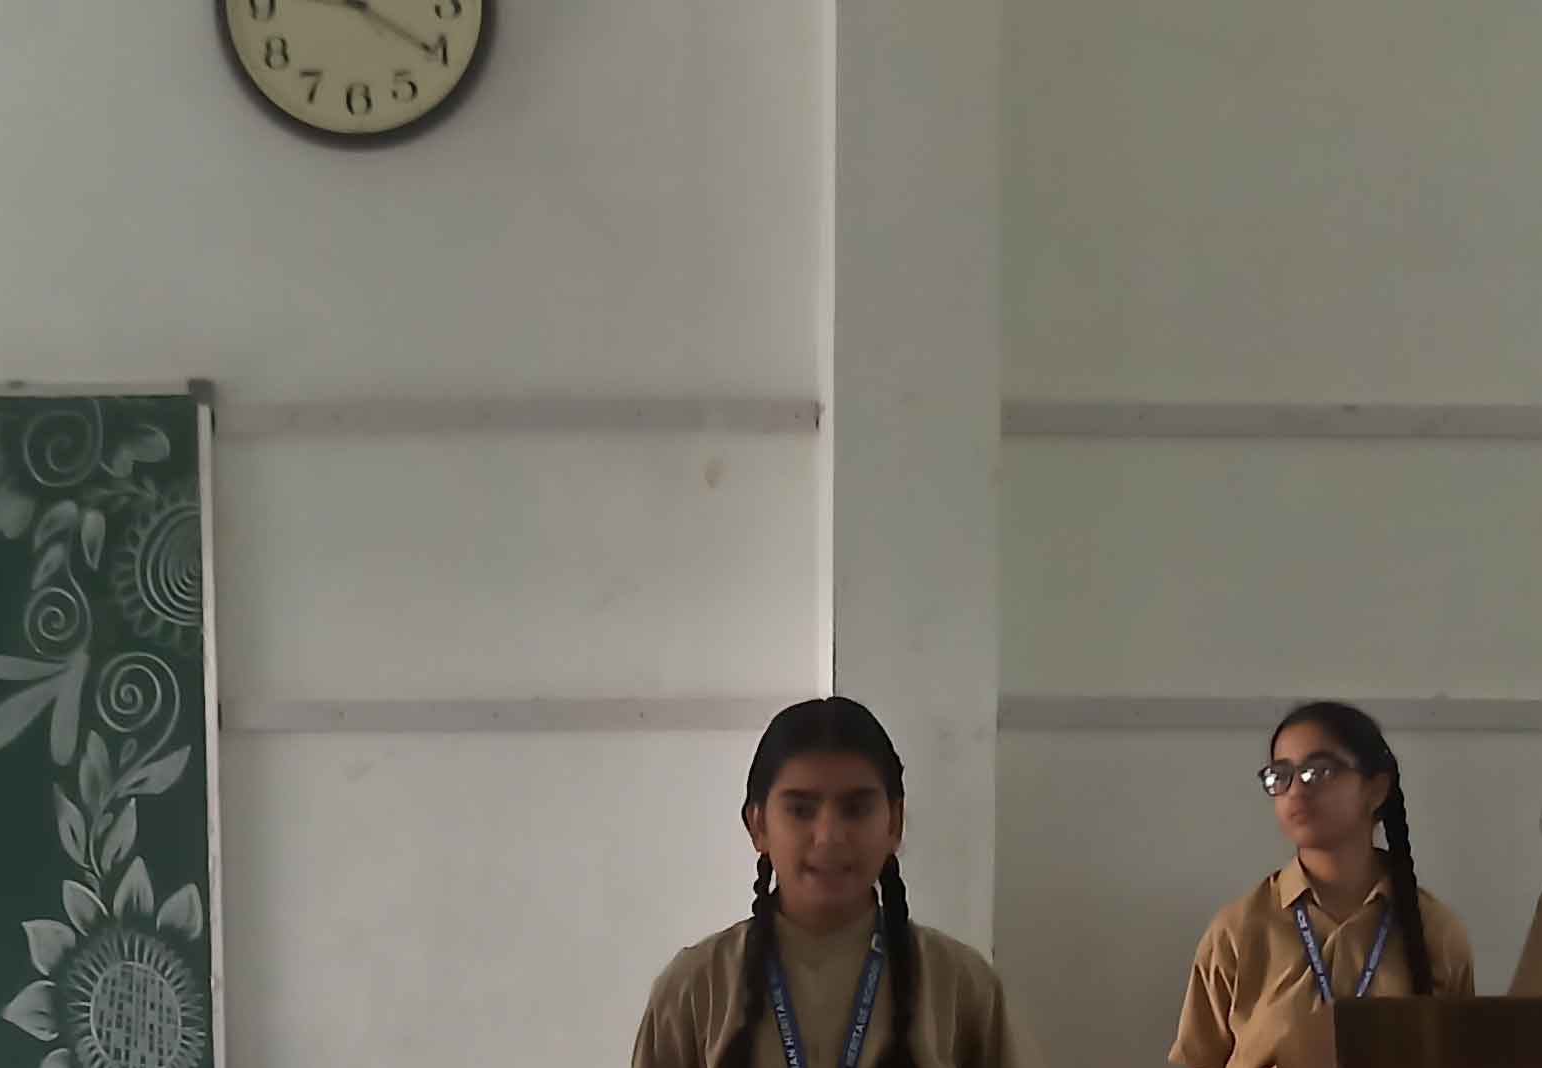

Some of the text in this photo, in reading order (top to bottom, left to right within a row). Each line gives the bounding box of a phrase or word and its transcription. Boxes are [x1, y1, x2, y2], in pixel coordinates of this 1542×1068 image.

[264, 37, 289, 70] 8
[425, 34, 449, 66] 4
[299, 69, 323, 103] 7
[345, 83, 373, 116] 6
[391, 70, 418, 101] 5
